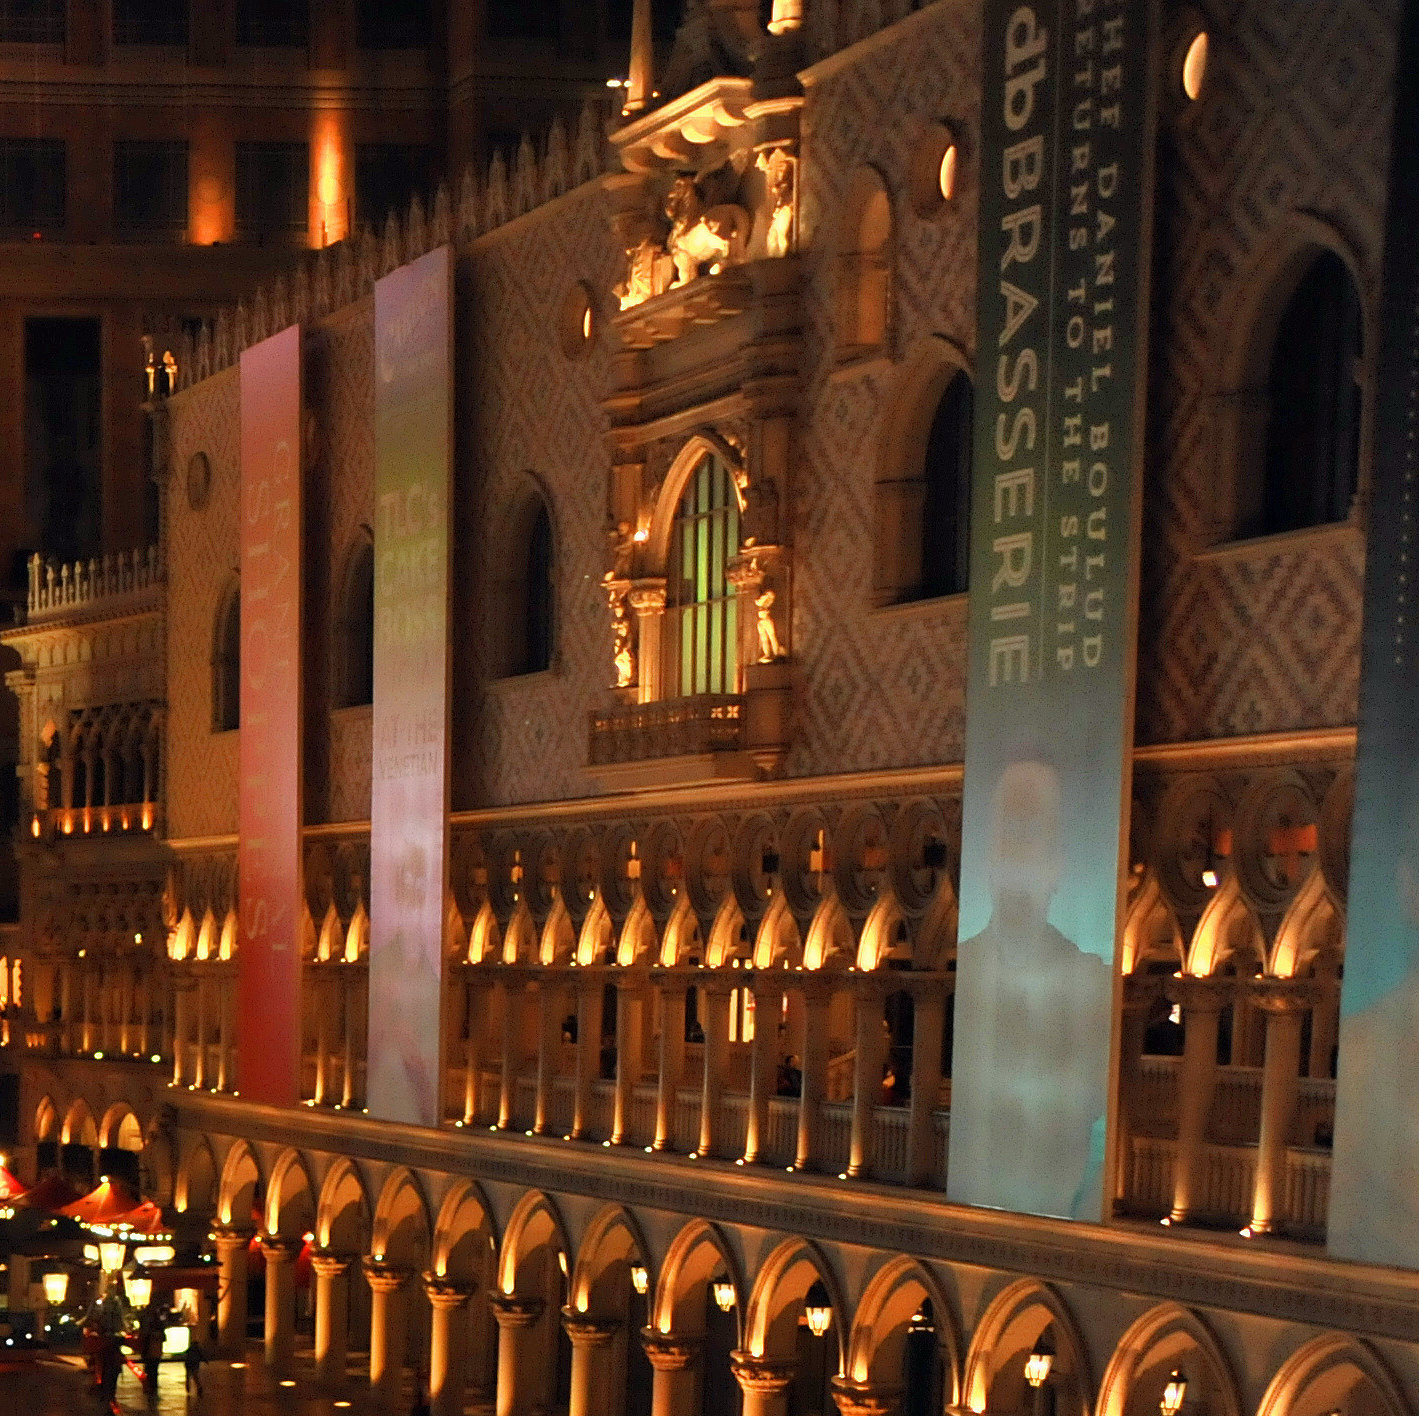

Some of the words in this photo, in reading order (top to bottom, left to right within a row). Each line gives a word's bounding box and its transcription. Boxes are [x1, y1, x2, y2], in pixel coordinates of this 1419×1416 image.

[1101, 0, 1124, 127] HEF
[1066, 277, 1085, 349] TO
[1091, 162, 1118, 391] DANIEL
[1063, 377, 1082, 483] THE
[1057, 515, 1078, 671] STRIP
[1083, 423, 1109, 668] BOULUD
